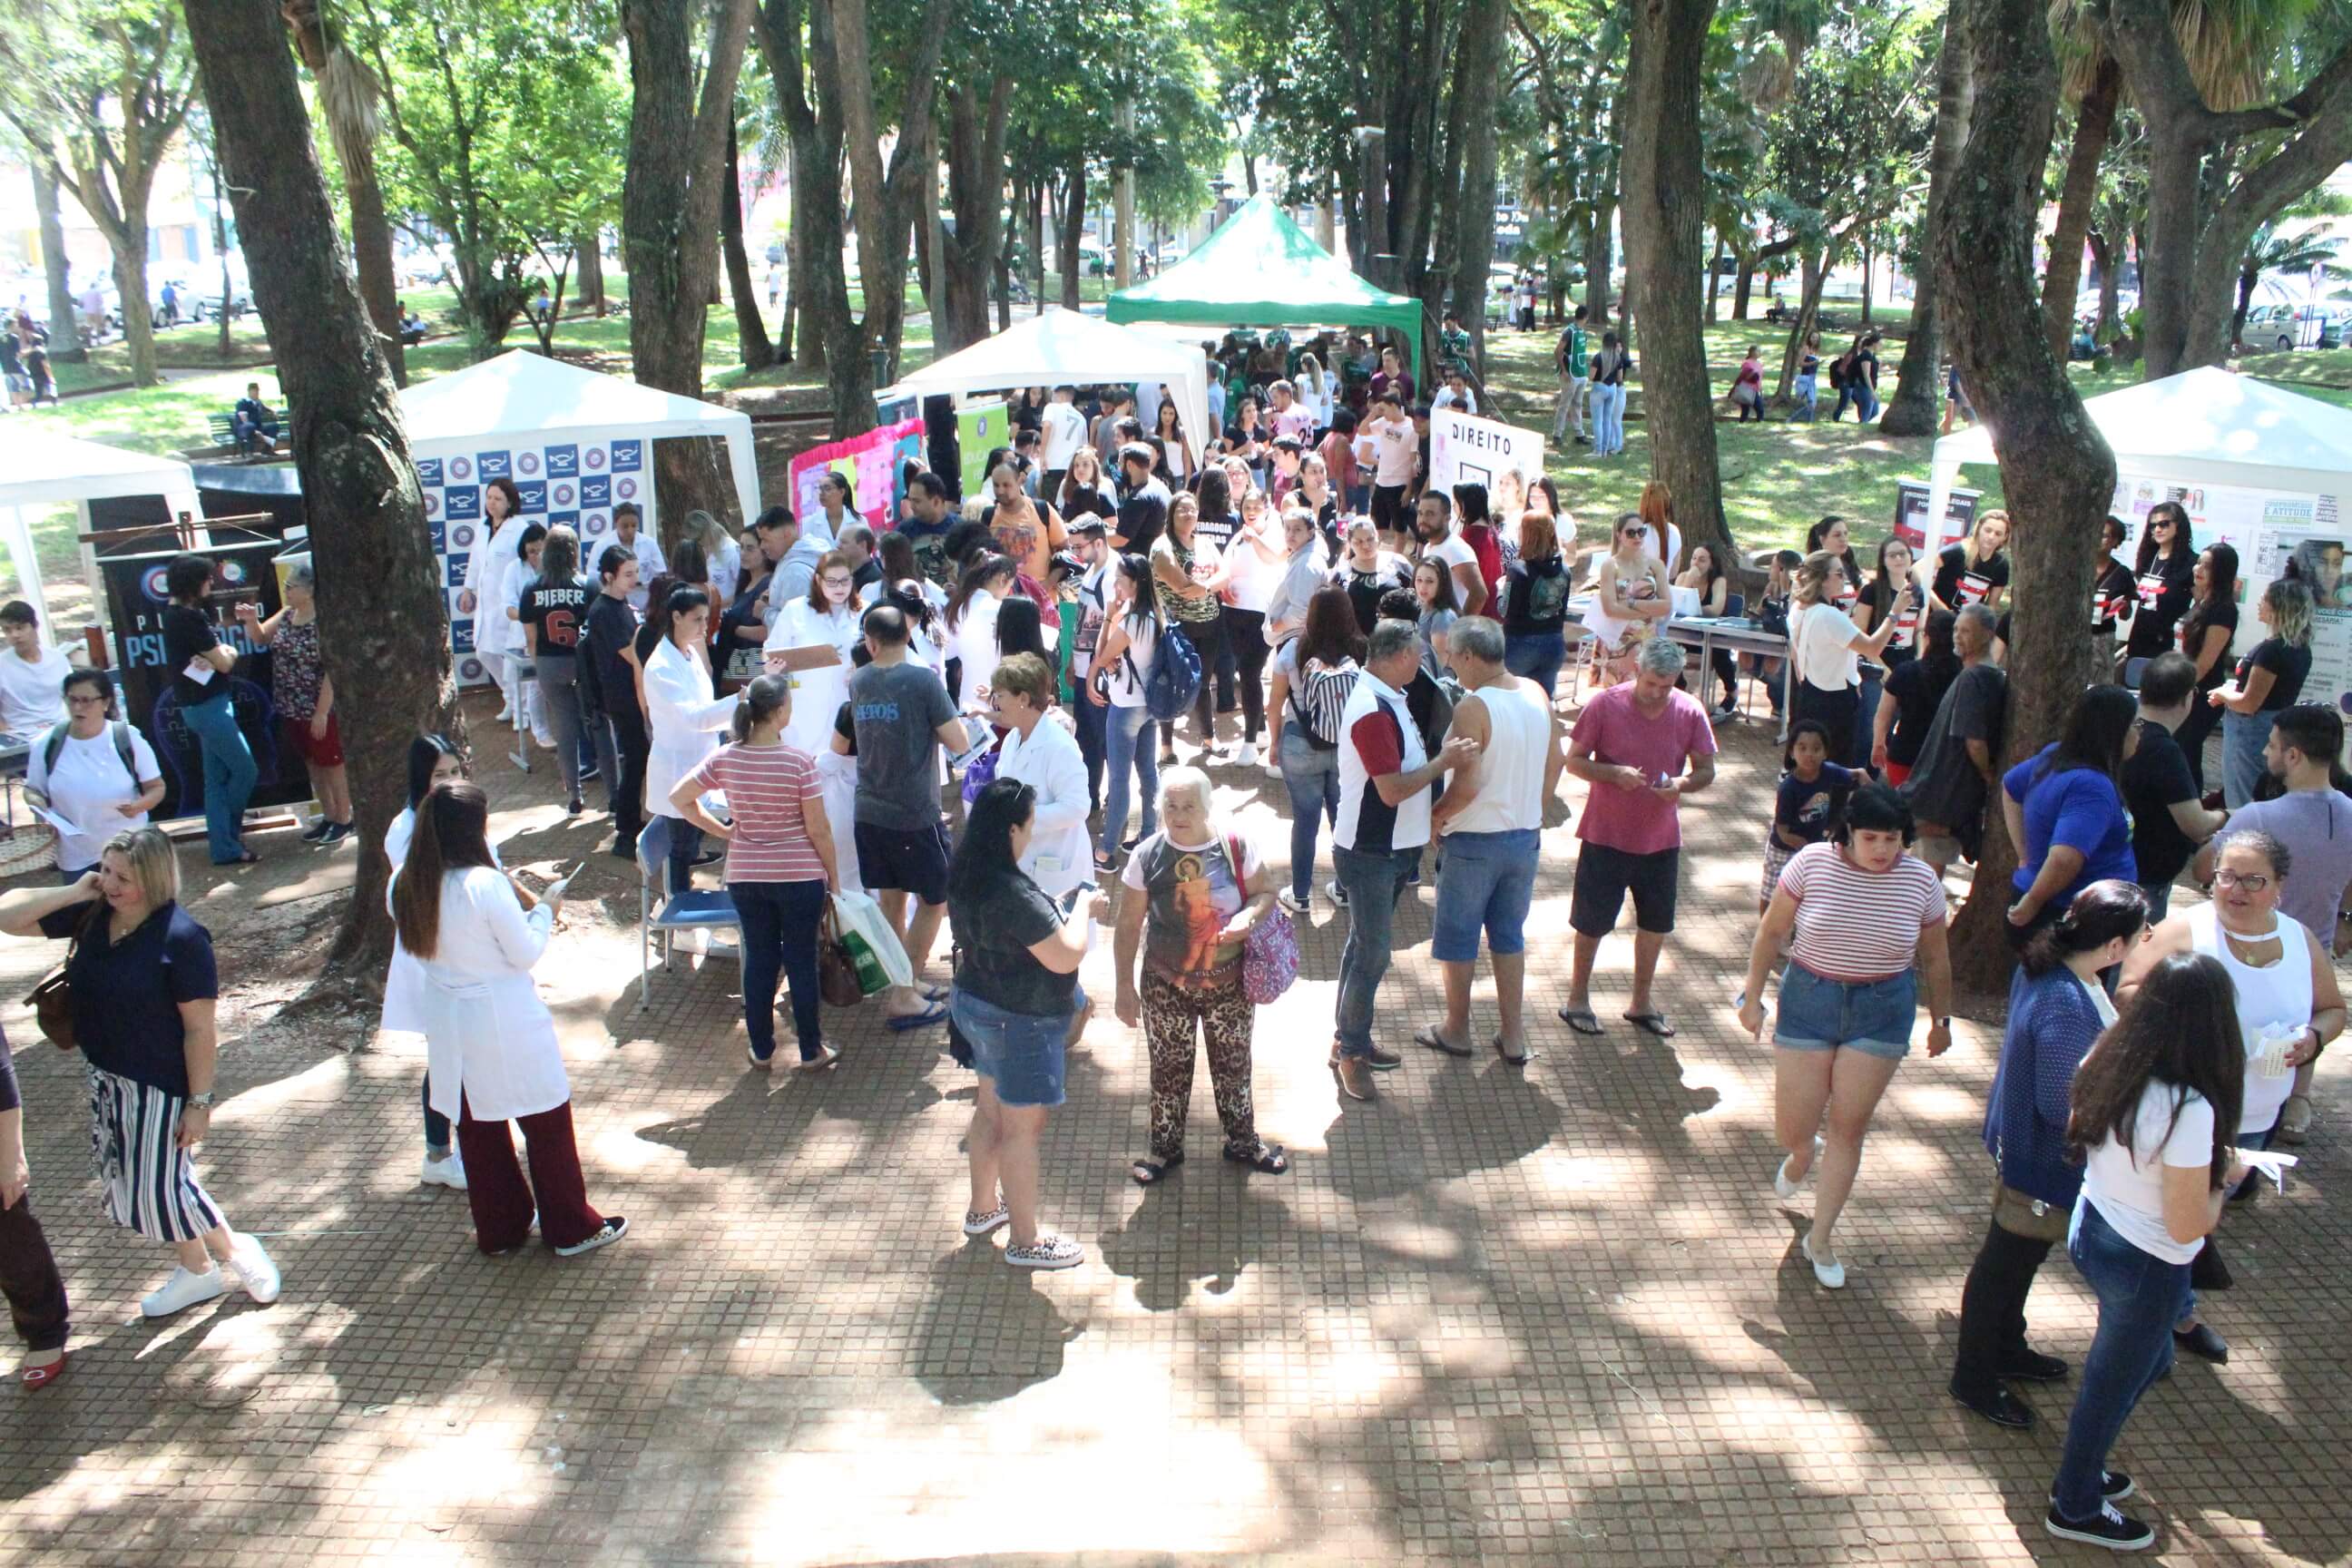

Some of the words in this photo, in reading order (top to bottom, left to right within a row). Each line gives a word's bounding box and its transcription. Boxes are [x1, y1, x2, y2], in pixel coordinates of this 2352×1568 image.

[1066, 414, 1081, 441] 7
[1453, 423, 1511, 456] DIREITO
[2272, 508, 2312, 516] ATITUDE
[1197, 521, 1232, 534] EDAGOGIA
[533, 588, 585, 608] BIEBER
[546, 610, 578, 648] 6
